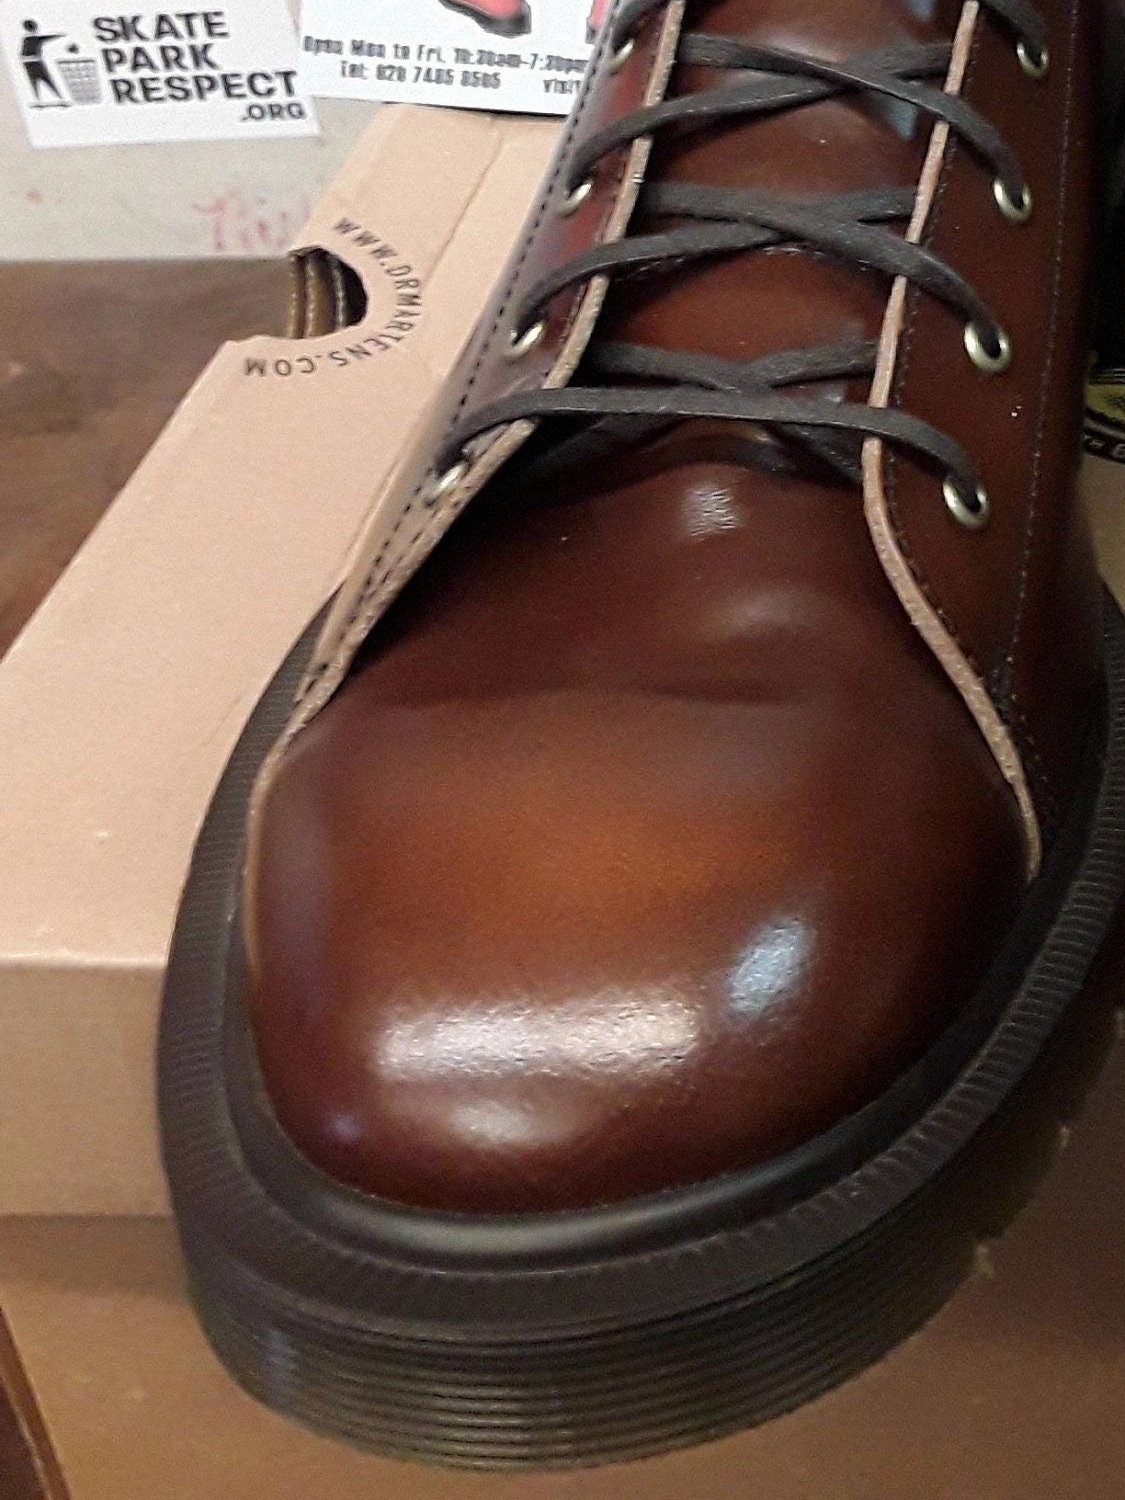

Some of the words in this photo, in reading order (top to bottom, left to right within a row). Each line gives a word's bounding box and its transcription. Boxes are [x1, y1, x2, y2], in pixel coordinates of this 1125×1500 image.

[93, 11, 229, 43] SKATE
[104, 43, 218, 72] PARK
[111, 70, 298, 102] RESPECT
[241, 103, 306, 122] .ORG
[244, 217, 422, 377] WWW.DRMARTENS.COM
